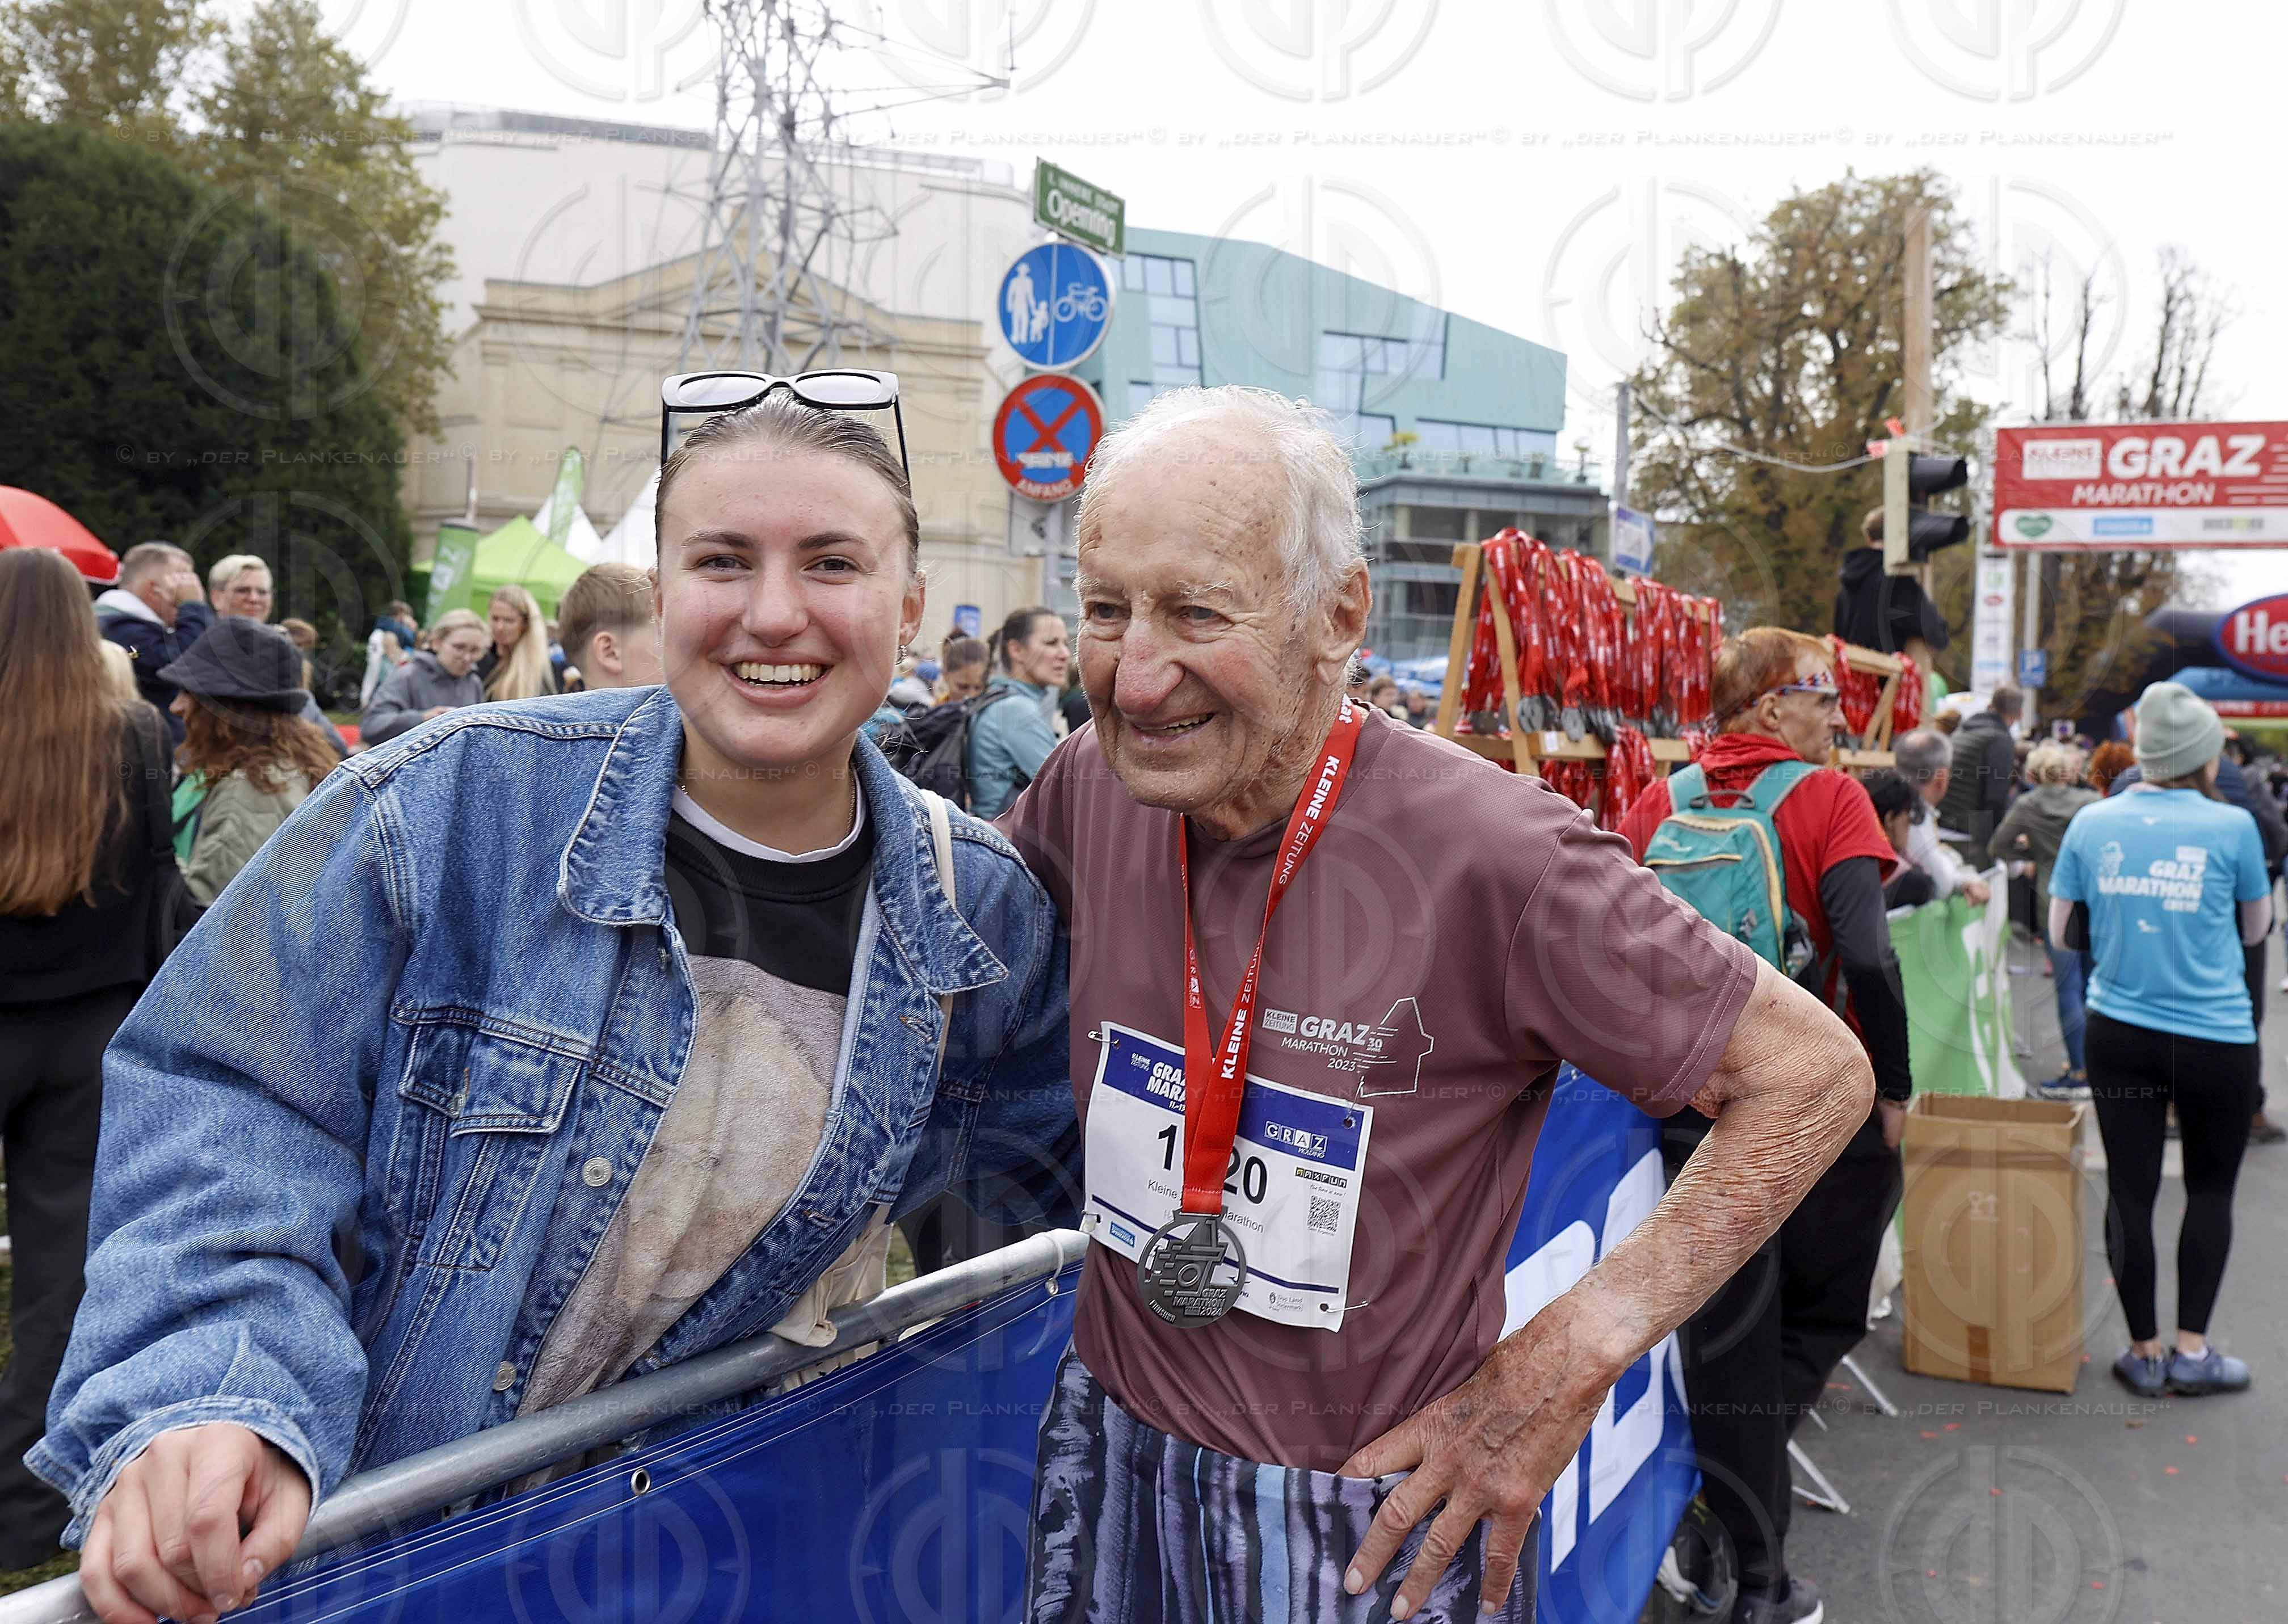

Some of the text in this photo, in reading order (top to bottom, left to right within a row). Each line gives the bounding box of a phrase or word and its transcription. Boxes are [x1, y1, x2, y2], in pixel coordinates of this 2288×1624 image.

[2107, 434, 2266, 479] GRAZ
[2072, 482, 2216, 506] MARATHON
[1278, 755, 1340, 885] KLEINE ZEITUNG
[2098, 874, 2205, 902] MARATHON
[1299, 1016, 1371, 1046] GRAZ
[1221, 1008, 1247, 1079] KLEINE
[1281, 1036, 1349, 1058] MARATHON
[1327, 1058, 1356, 1072] 2023
[1266, 1124, 1326, 1151] GRAZ
[1147, 1179, 1178, 1200] Kleine
[1223, 1211, 1264, 1233] arathon
[1172, 1296, 1226, 1307] MARATHON
[1201, 1288, 1228, 1298] GRAZ
